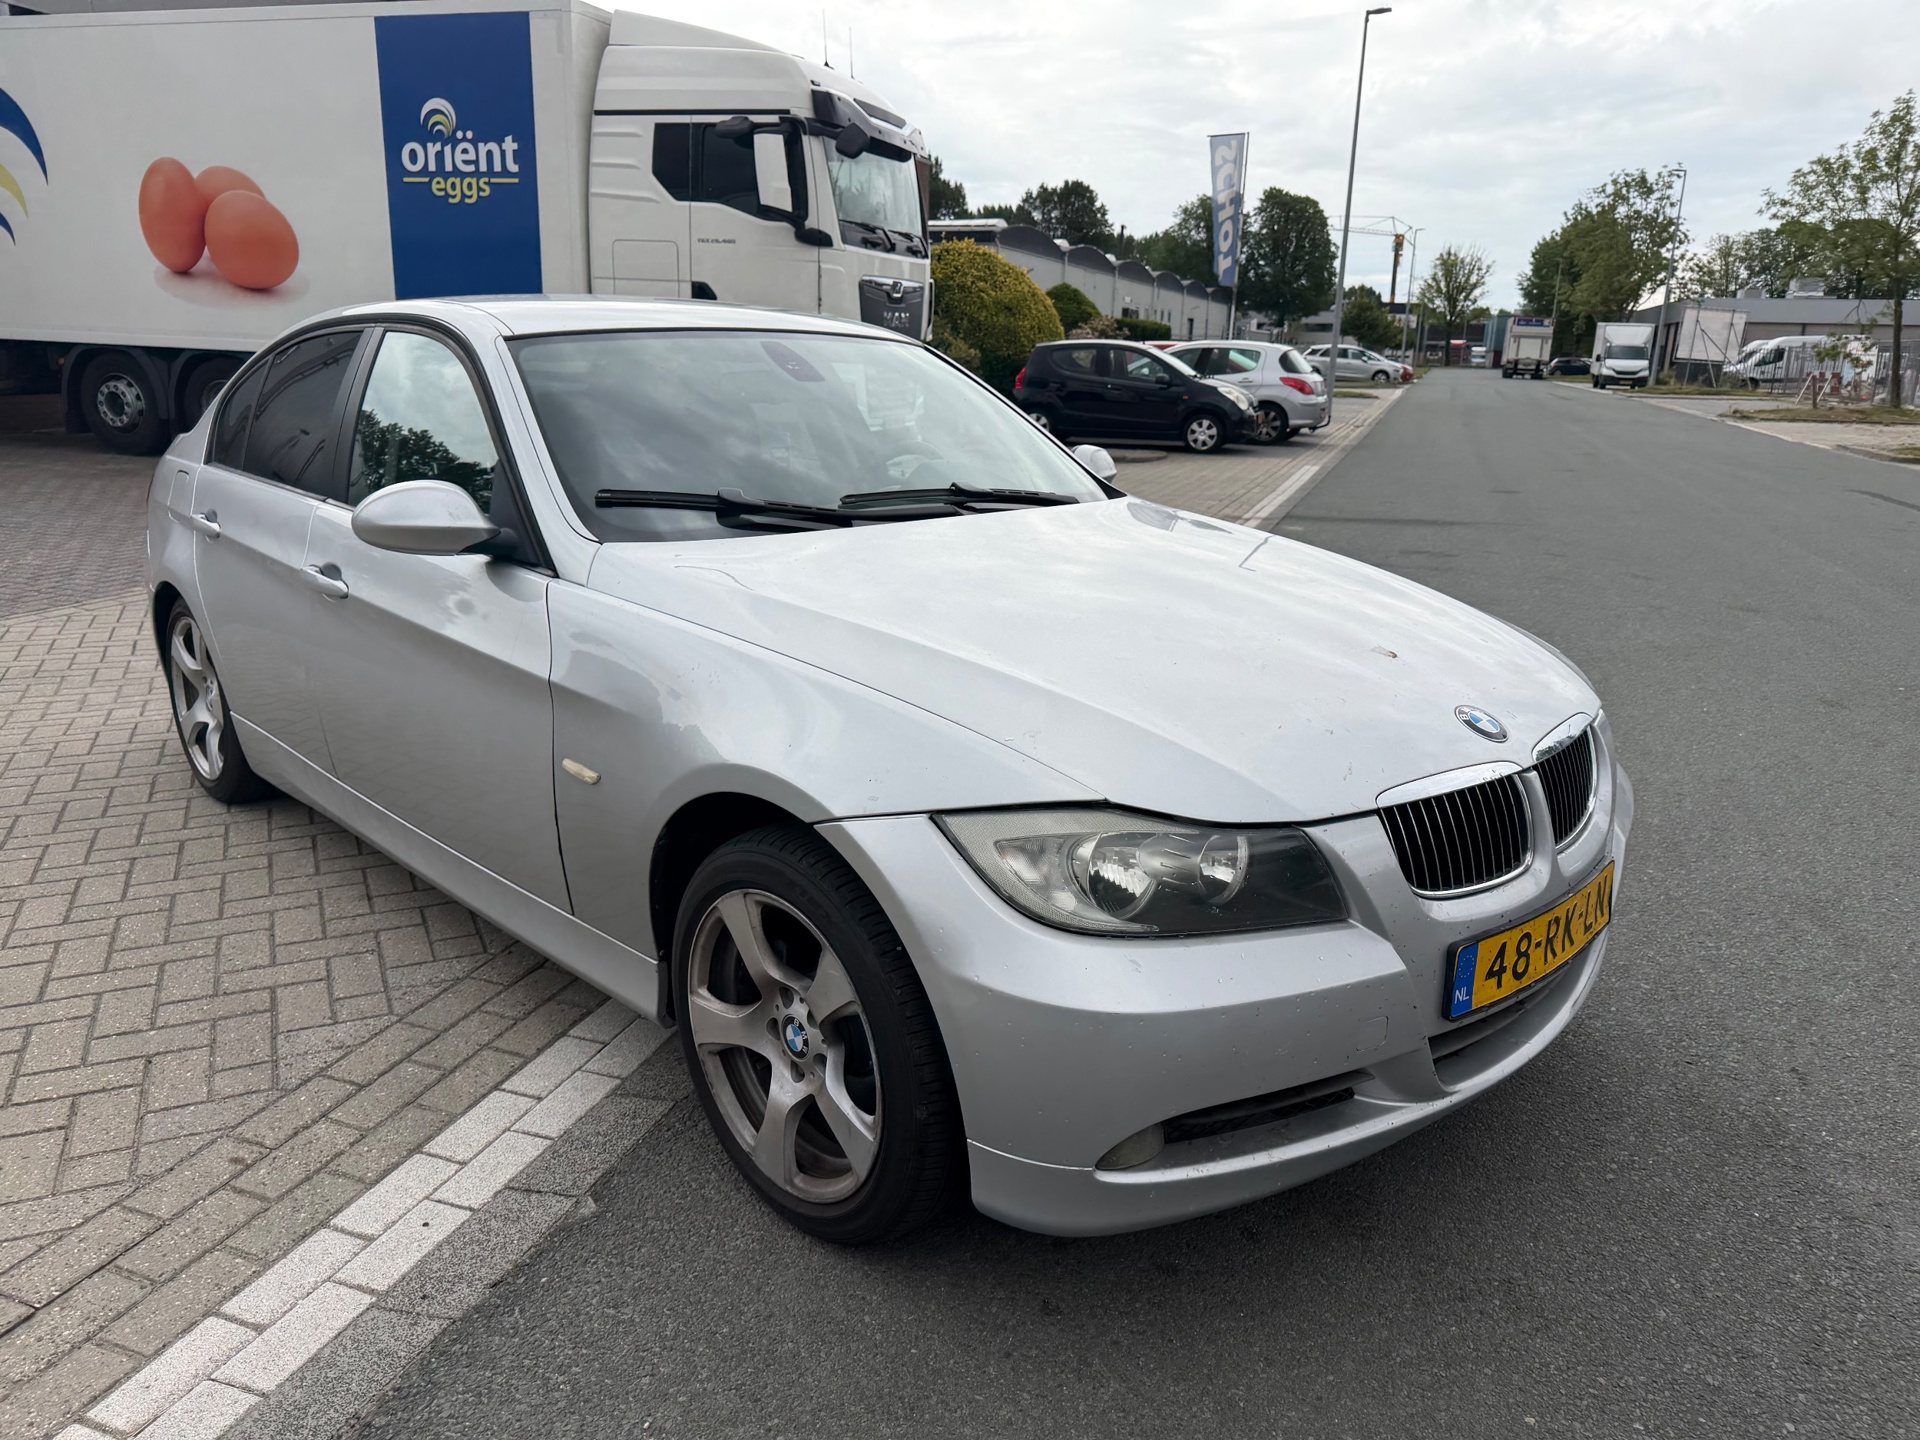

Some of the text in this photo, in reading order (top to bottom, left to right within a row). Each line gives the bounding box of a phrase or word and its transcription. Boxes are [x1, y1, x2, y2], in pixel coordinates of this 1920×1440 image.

[401, 130, 519, 173] oriënt
[431, 176, 491, 203] eggs
[883, 311, 910, 327] MAN
[1484, 874, 1608, 990] 48-RK-LN
[1454, 986, 1470, 1004] NL
[793, 1018, 809, 1054] BMW
